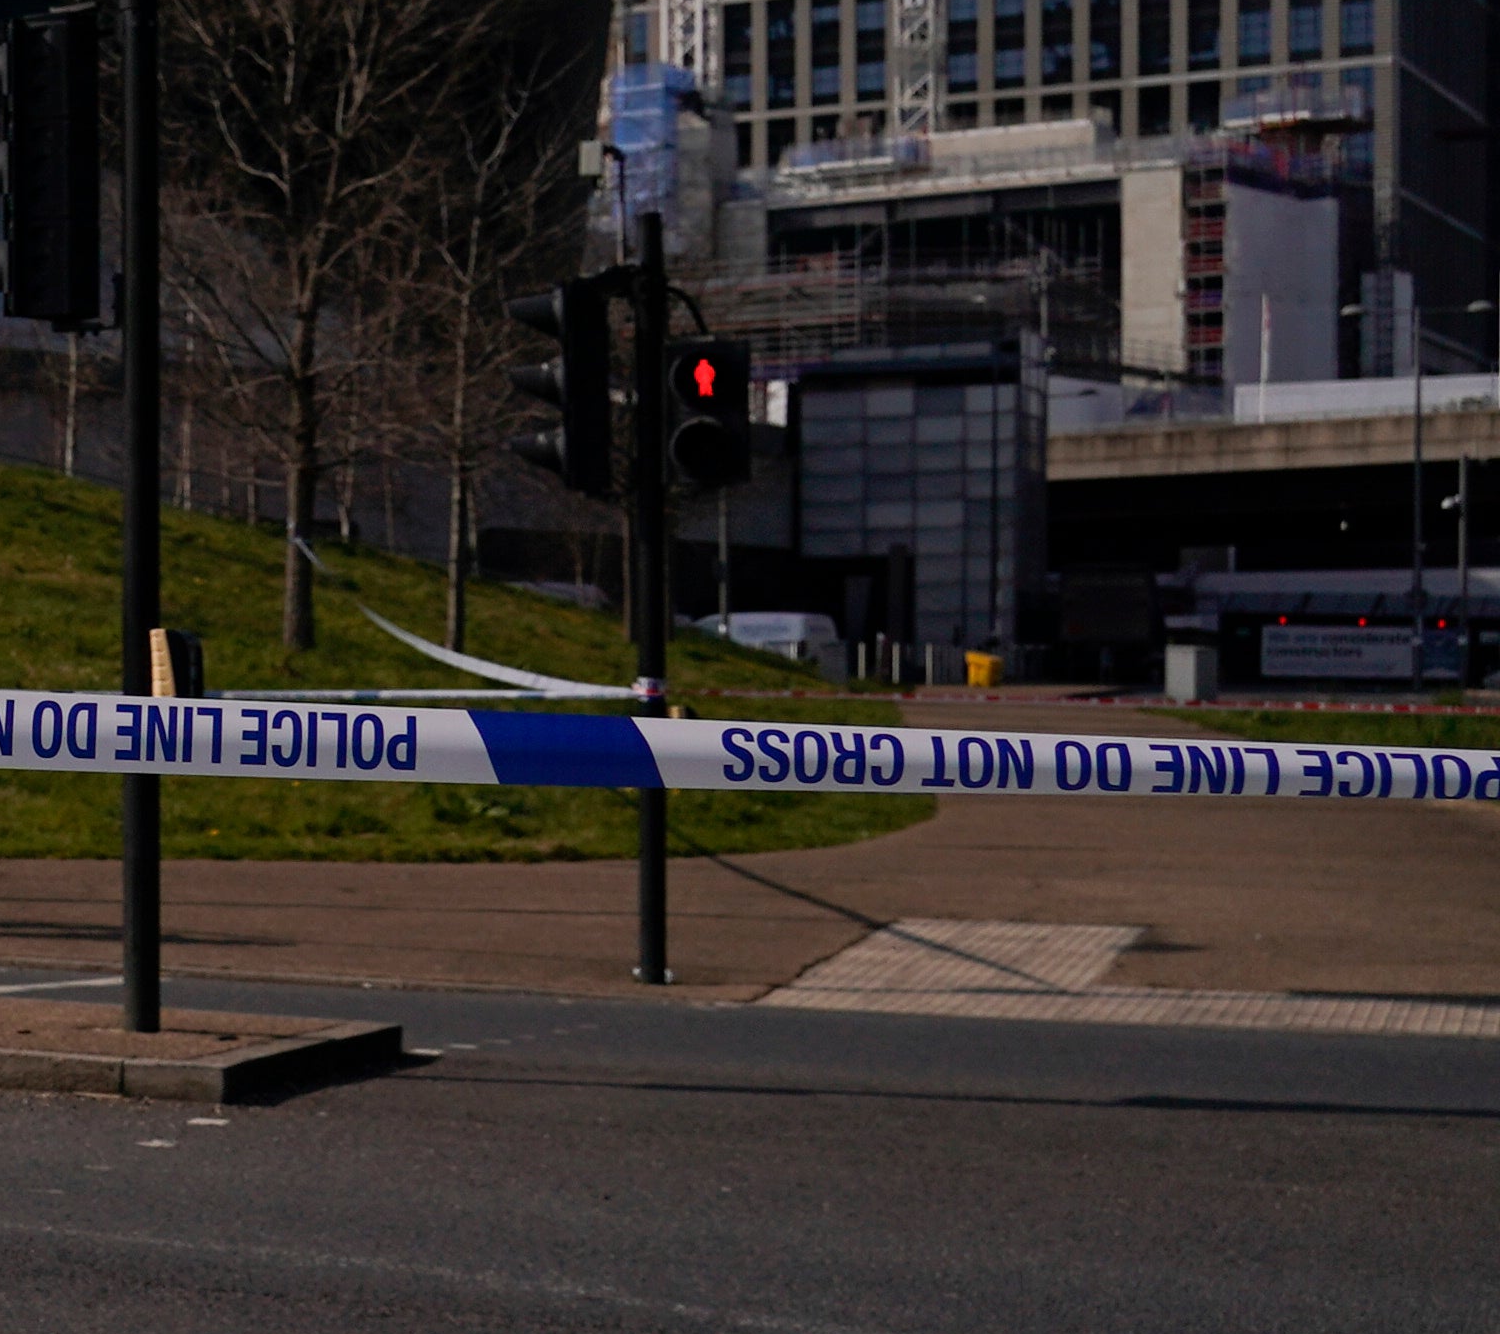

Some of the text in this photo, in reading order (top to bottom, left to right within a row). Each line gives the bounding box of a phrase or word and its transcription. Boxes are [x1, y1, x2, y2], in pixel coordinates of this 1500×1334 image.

[32, 700, 98, 761] DO
[115, 703, 223, 765] LINE
[241, 709, 418, 772] POLICE
[721, 727, 1500, 800] POLICE LINE DO NOT CROSS
